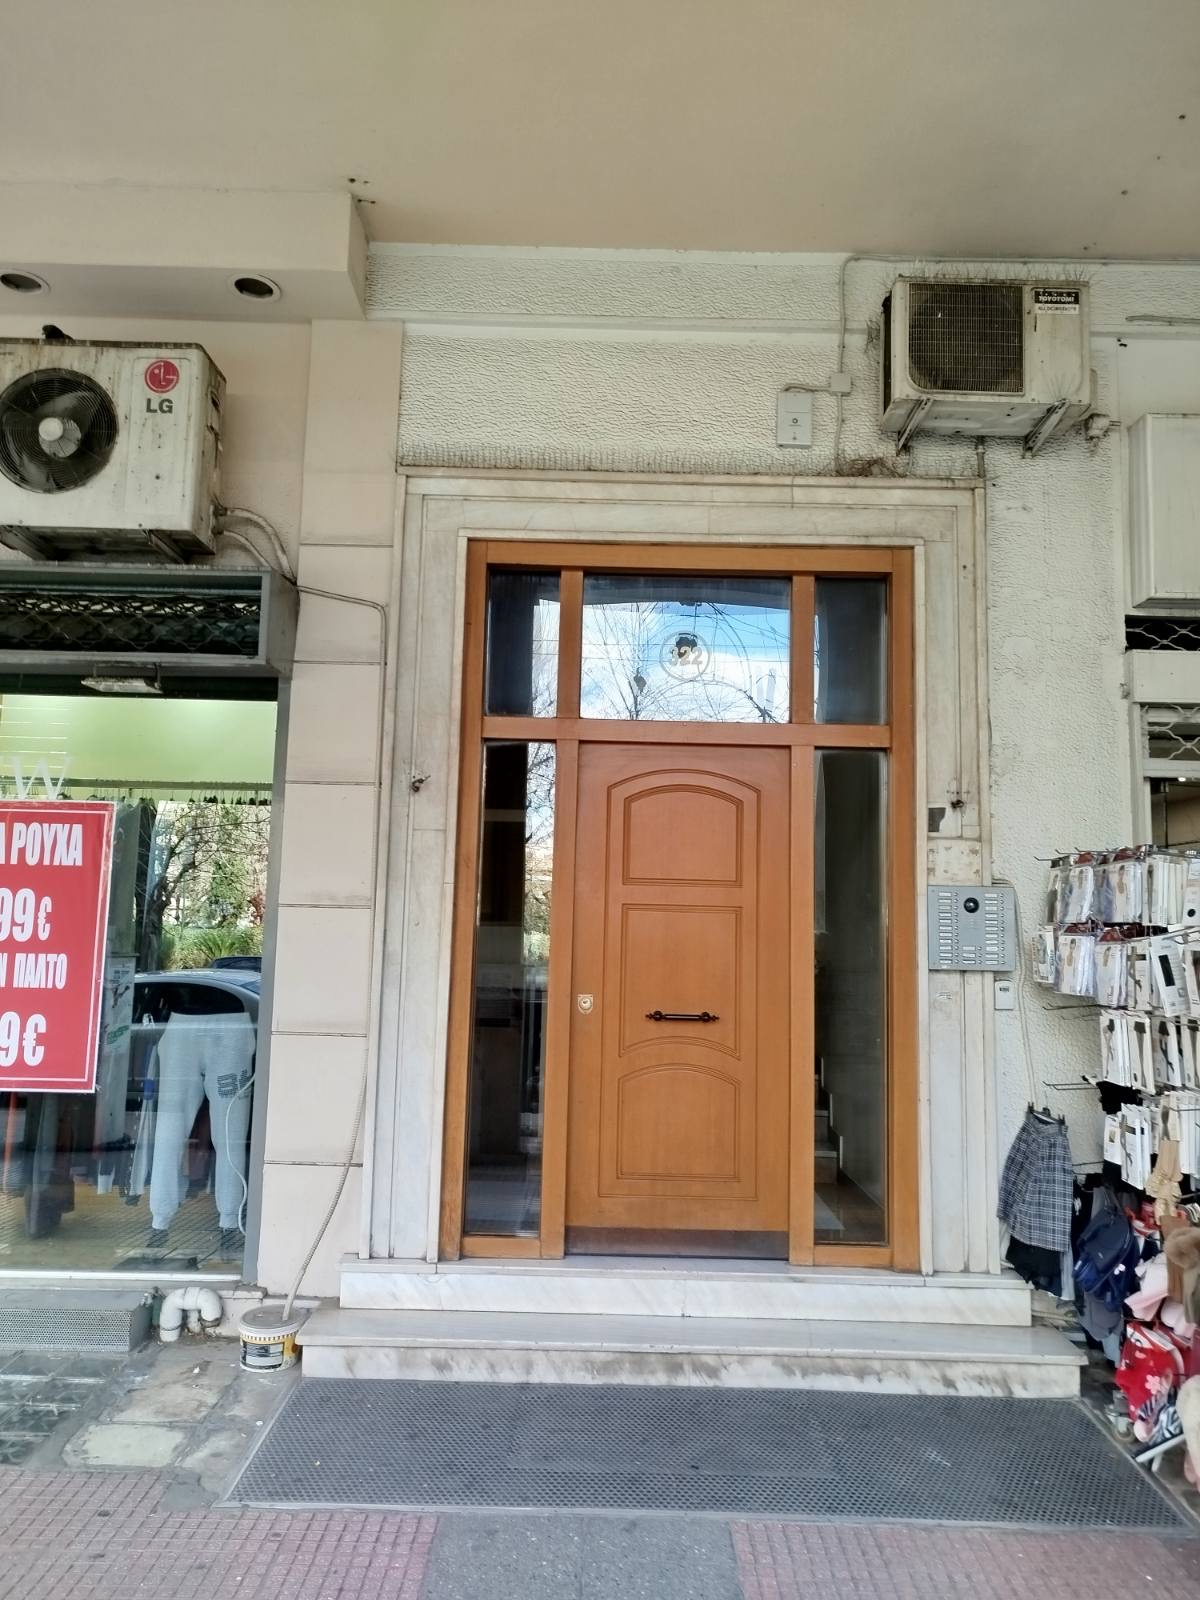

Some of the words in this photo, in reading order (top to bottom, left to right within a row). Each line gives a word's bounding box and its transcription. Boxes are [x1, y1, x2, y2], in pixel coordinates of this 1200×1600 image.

[146, 398, 174, 413] LG
[10, 822, 83, 866] ΡΟΥΧΑ
[13, 953, 67, 989] ΠΑΛΤΟ
